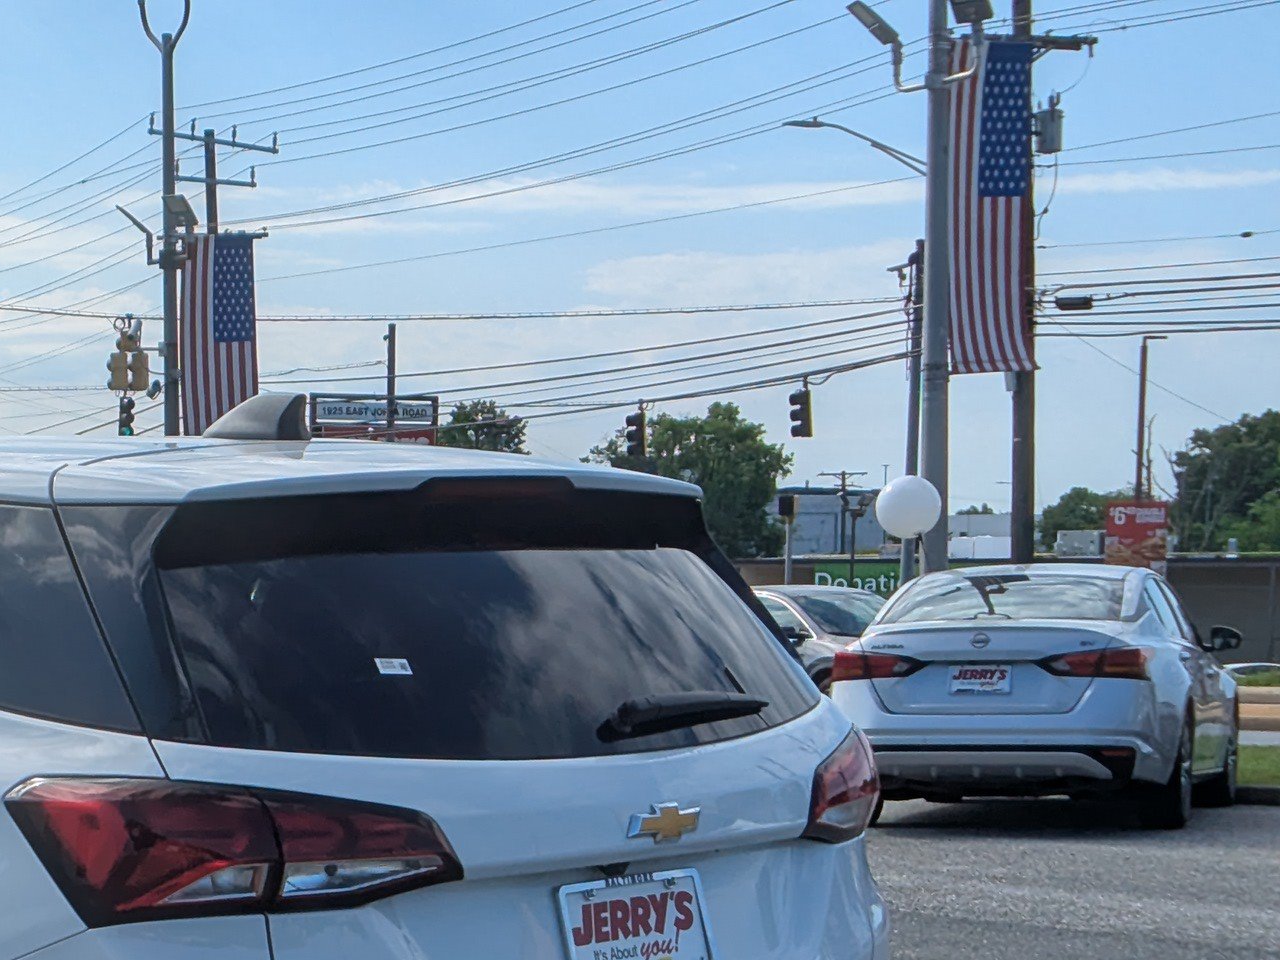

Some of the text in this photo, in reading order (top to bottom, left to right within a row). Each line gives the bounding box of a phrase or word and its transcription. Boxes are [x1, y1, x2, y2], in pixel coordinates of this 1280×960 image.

[346, 407, 368, 416] EAST
[371, 407, 399, 417] JOA
[402, 408, 427, 418] ROAD
[815, 571, 902, 593] Donati
[952, 669, 1008, 681] JERRY'S
[572, 890, 693, 947] JERRY'S
